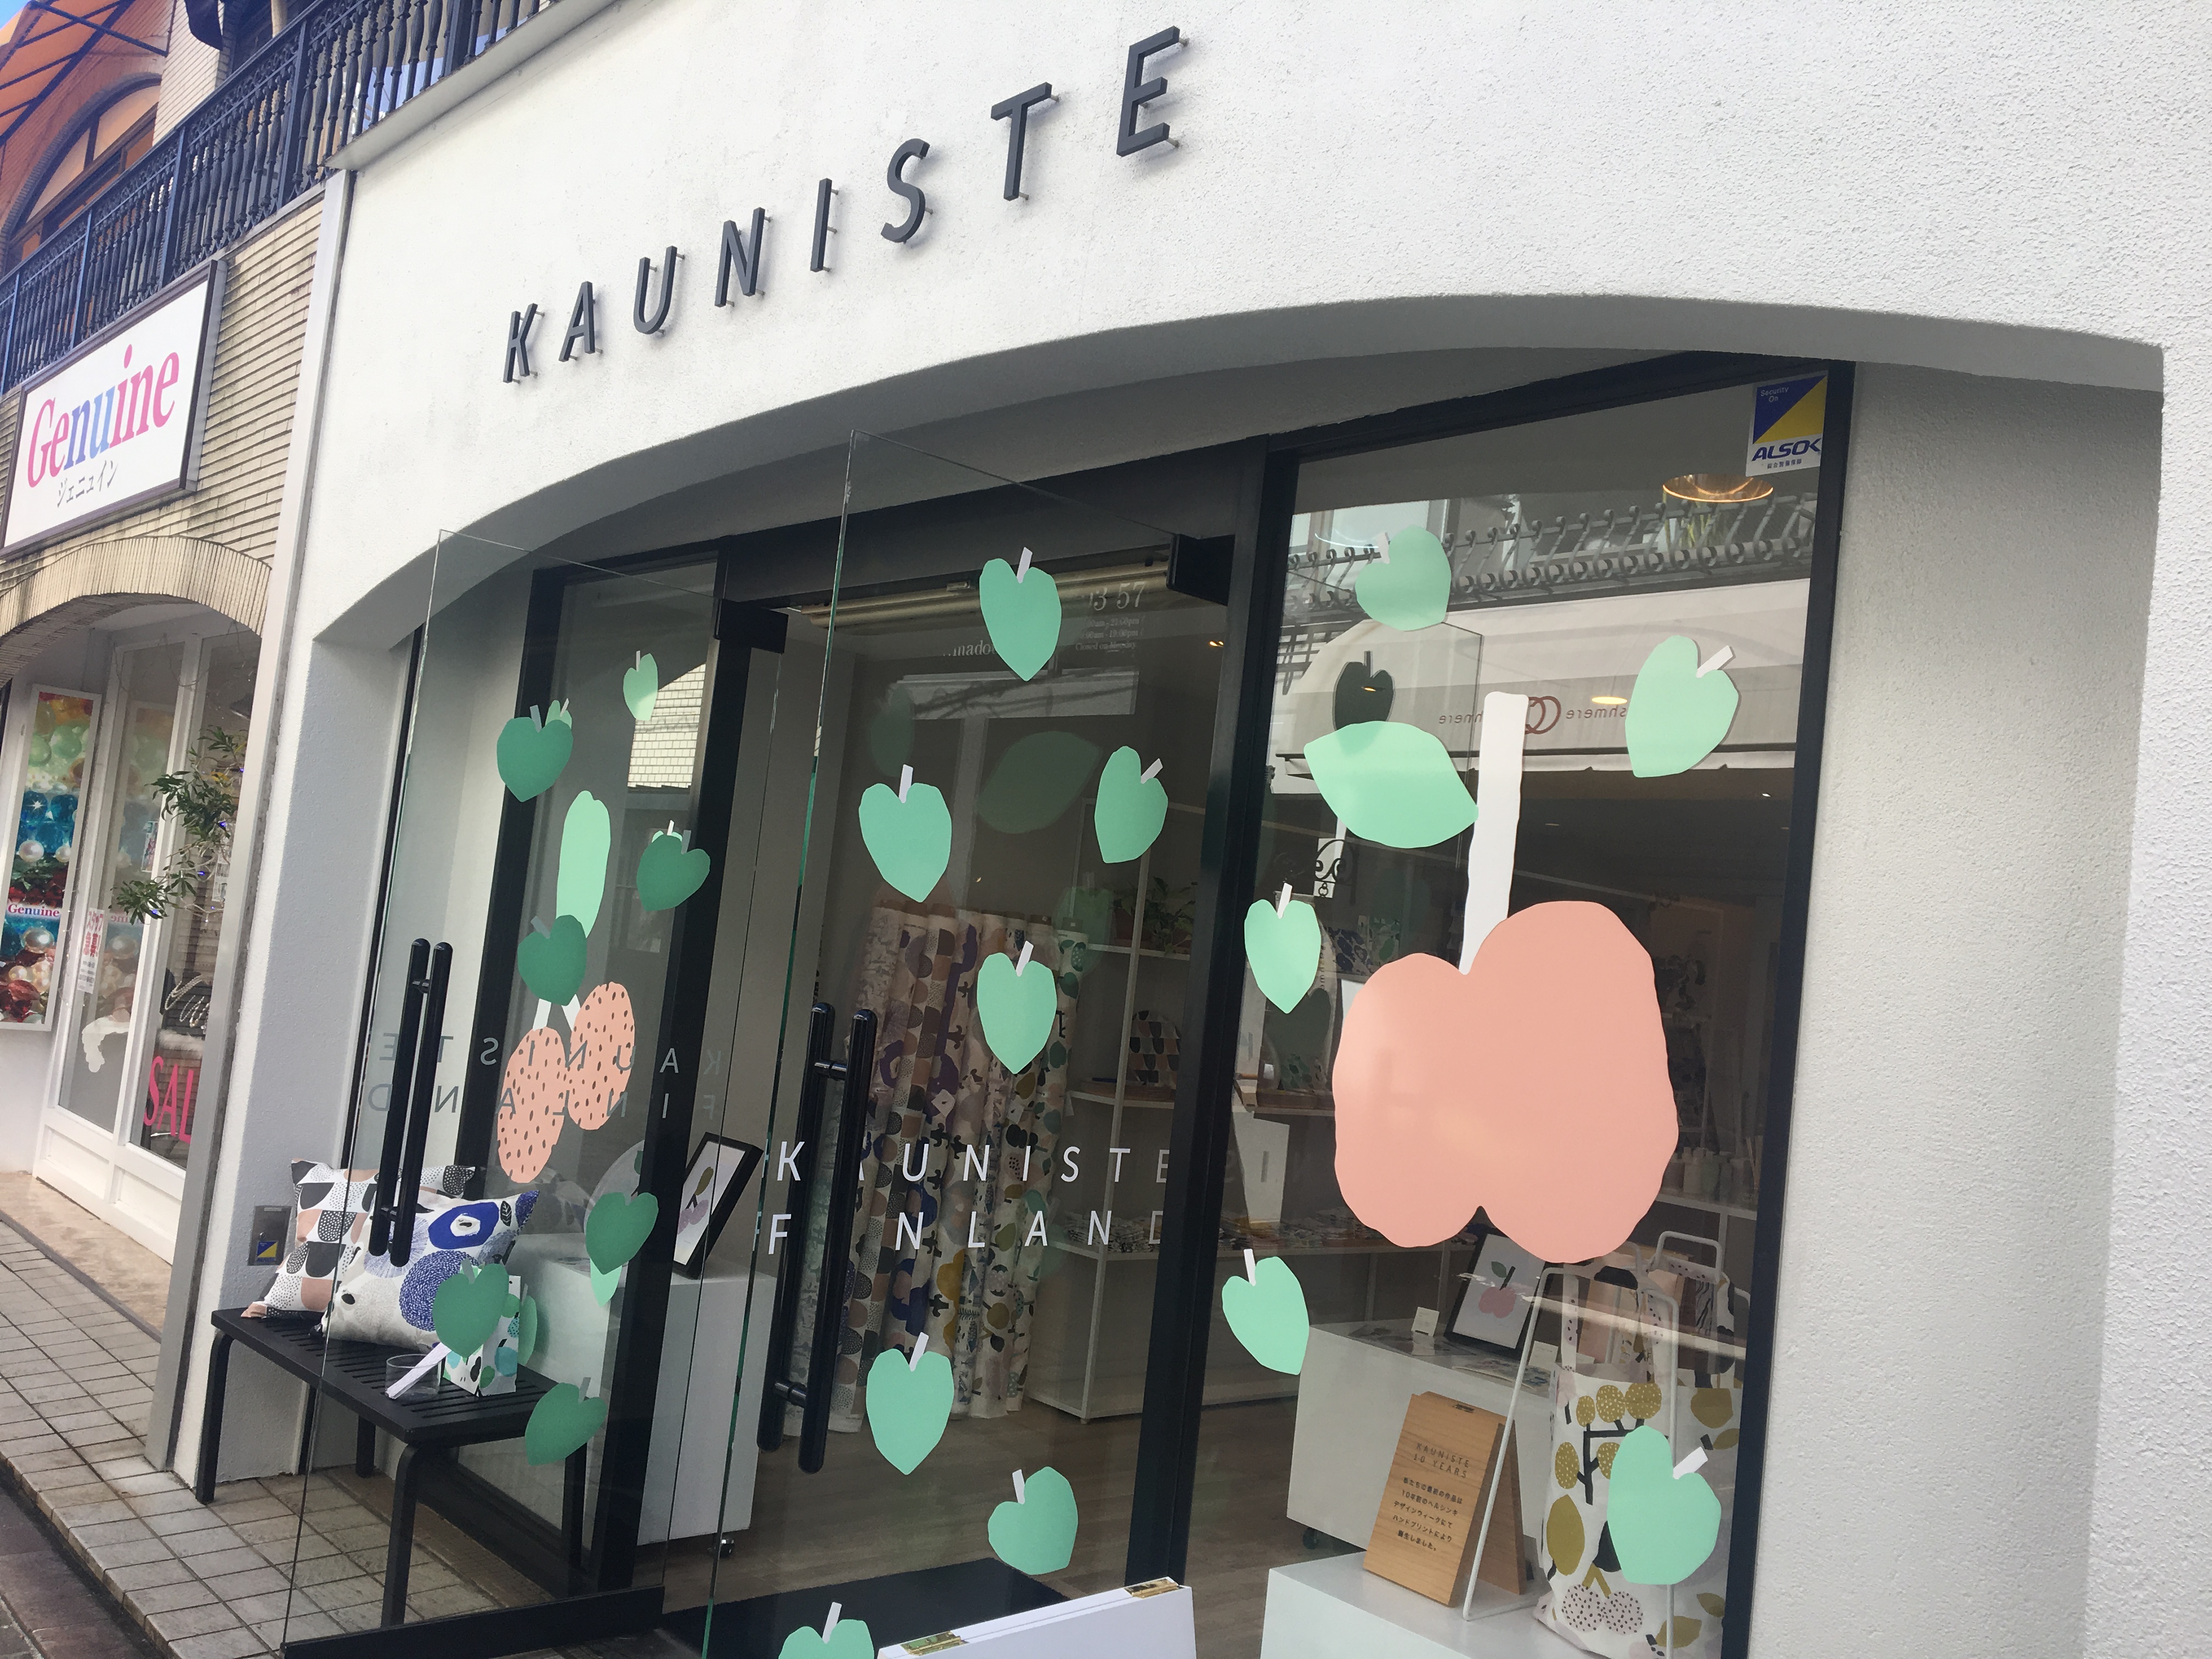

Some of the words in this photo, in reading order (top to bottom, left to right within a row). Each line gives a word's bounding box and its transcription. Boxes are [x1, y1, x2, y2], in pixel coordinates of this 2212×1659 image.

[503, 26, 1181, 383] KAUNISTE
[1760, 386, 1790, 397] Security
[27, 344, 179, 488] Genuine
[1751, 438, 1822, 462] ALSOK
[57, 459, 118, 508] ジェニュイン
[8, 903, 60, 918] Genuine
[776, 1141, 1170, 1183] KUNISTE
[1413, 1453, 1425, 1463] 10
[1432, 1459, 1467, 1479] YEARS
[1416, 1442, 1470, 1468] KAUNISTE
[1392, 1514, 1452, 1543] ハンドプリントにより
[1393, 1500, 1453, 1529] デザインウィークにて
